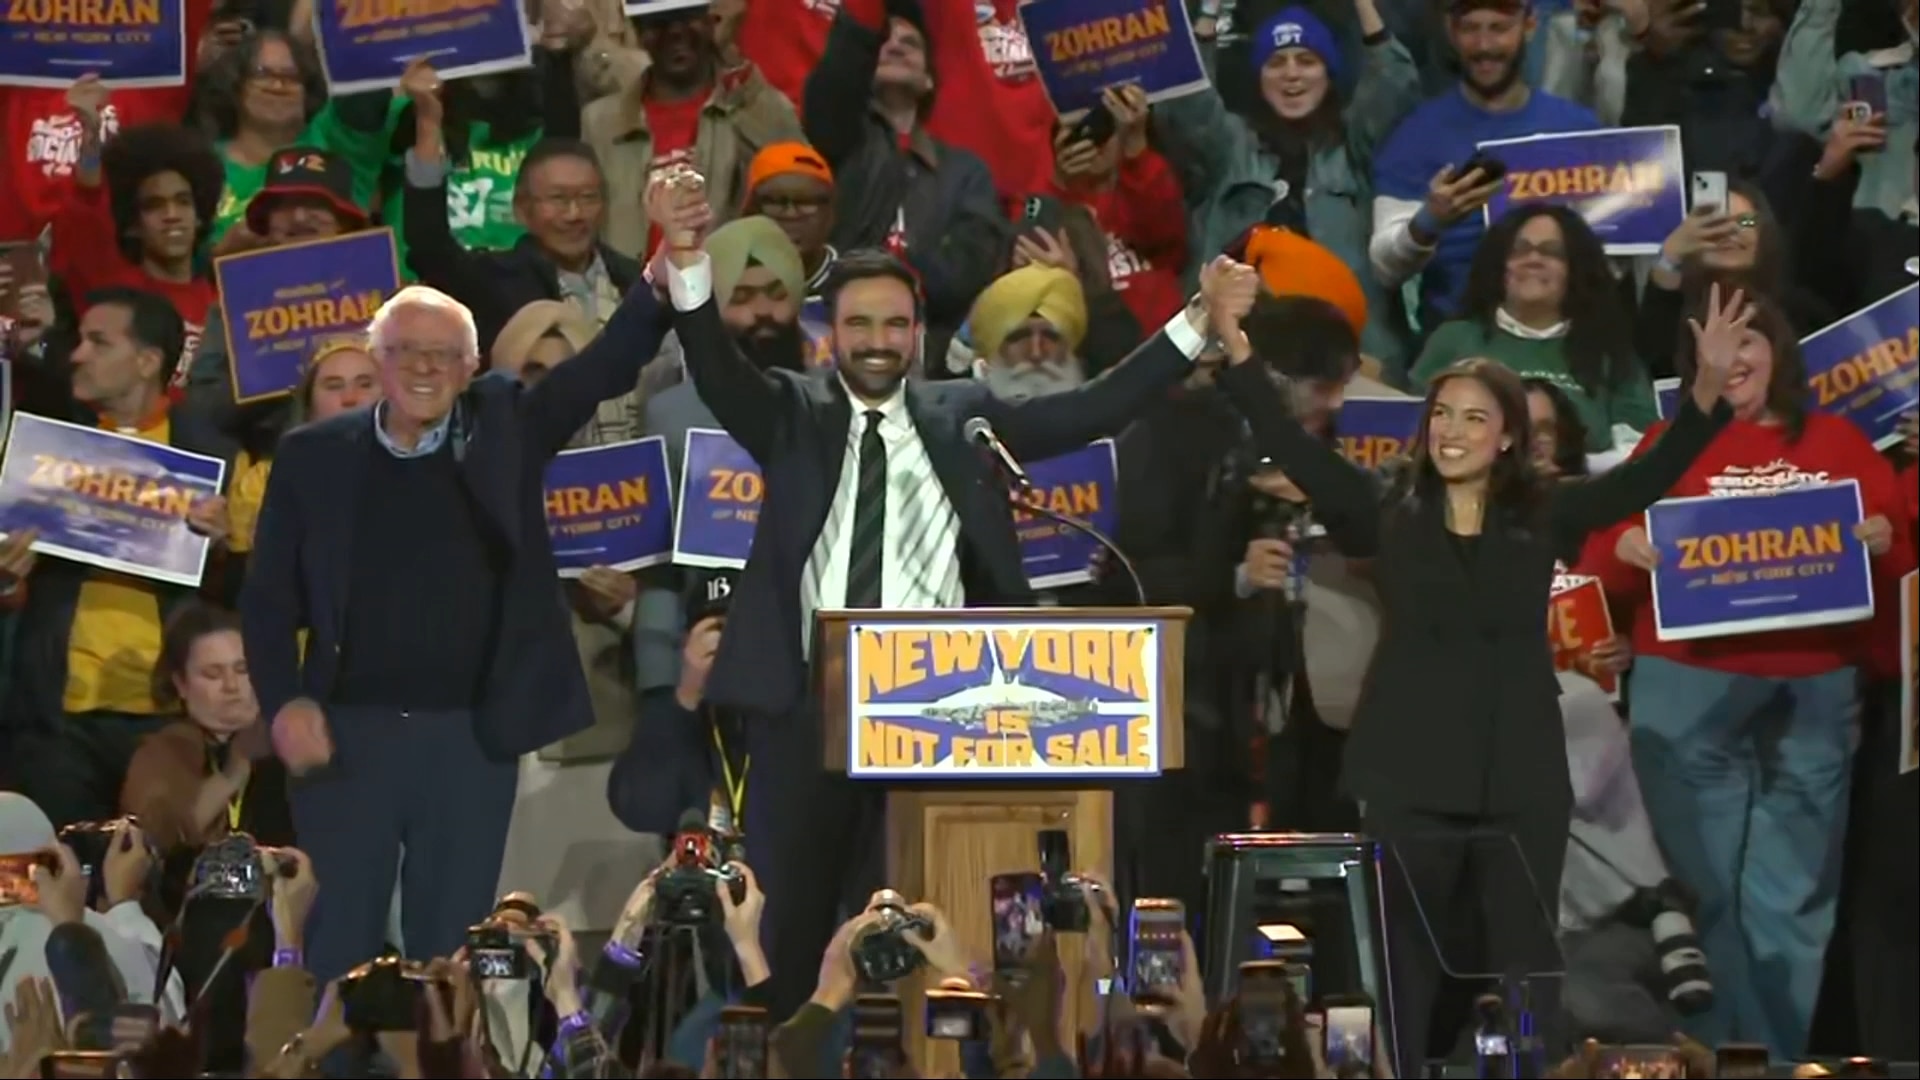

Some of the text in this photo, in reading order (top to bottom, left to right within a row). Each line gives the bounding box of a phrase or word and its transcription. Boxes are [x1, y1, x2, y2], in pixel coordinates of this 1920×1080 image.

[8, 0, 160, 24] ZOHRAN
[1045, 5, 1170, 62] ZOHRAN
[244, 290, 381, 340] ZOHRAN
[28, 453, 195, 519] ZOHRAN
[708, 469, 762, 503] ZO
[606, 513, 642, 530] CITY
[1676, 522, 1843, 570] ZOHRAN
[1797, 562, 1836, 577] CITY
[1547, 598, 1583, 648] E
[858, 630, 1150, 704] NEW YORK
[858, 714, 1150, 768] NOT FOR SALE
[984, 709, 1030, 735] IS
